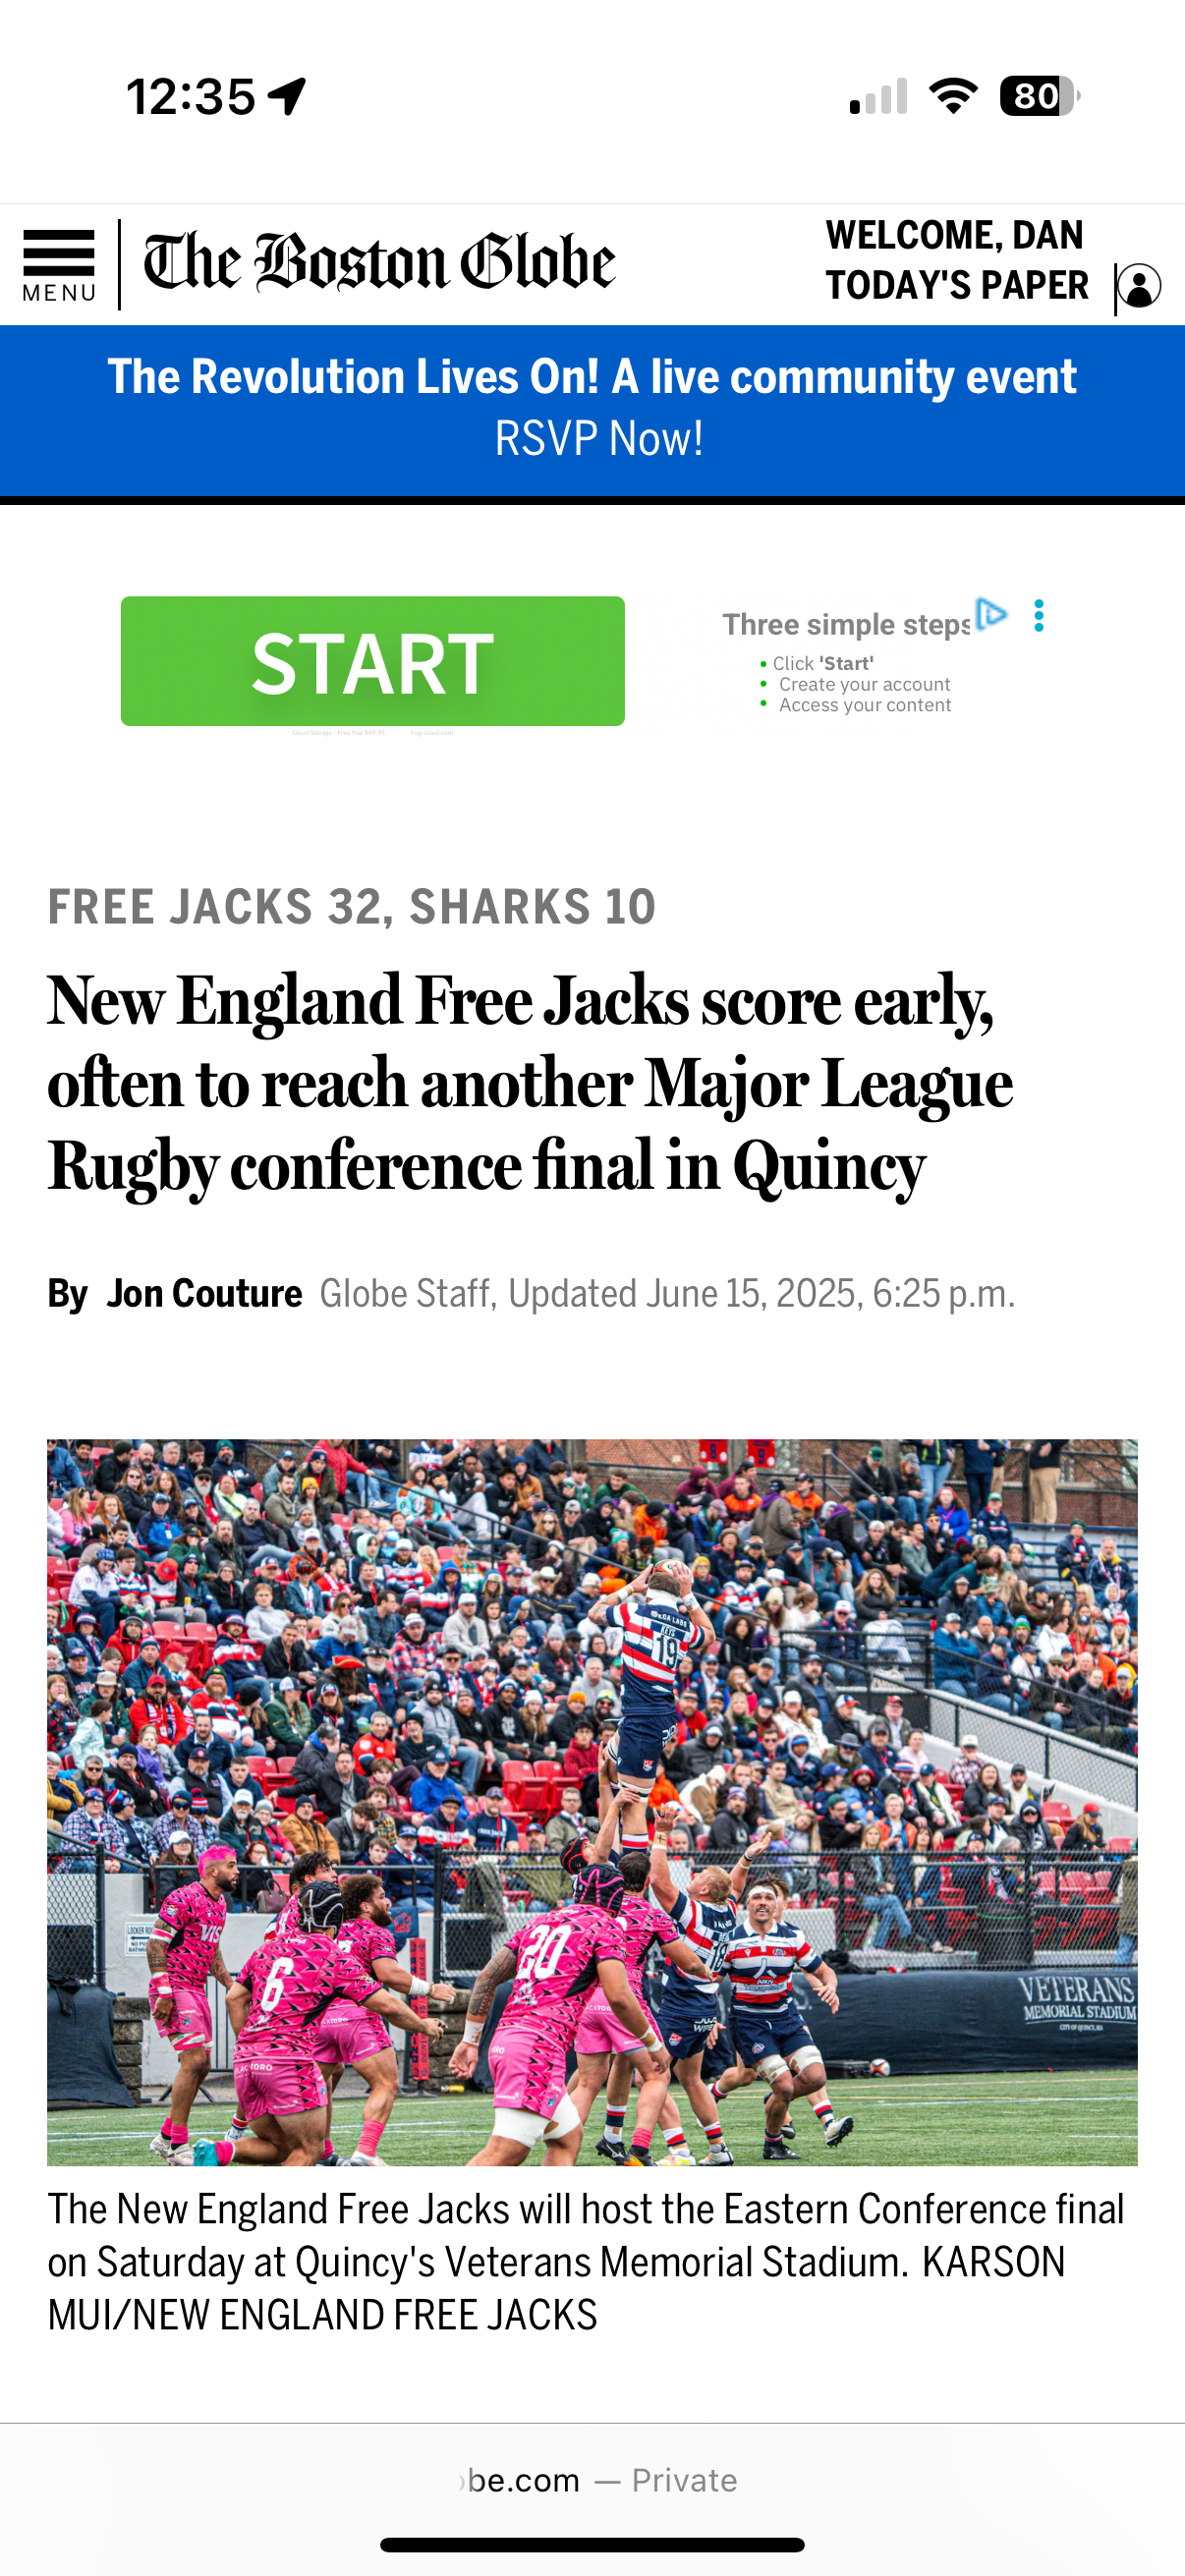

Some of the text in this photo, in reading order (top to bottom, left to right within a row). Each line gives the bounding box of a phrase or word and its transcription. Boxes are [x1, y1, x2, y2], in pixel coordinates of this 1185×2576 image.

[128, 78, 255, 116] 12:35
[1015, 83, 1058, 109] 80
[825, 219, 1083, 254] WELCOME, DAN
[144, 230, 617, 294] The Boston Globe
[24, 284, 95, 302] MENU
[825, 269, 1090, 301] TODAY'S PAPER
[108, 357, 1078, 404] The Revolution Lives On! A live community event
[497, 420, 702, 457] RSVP Now!
[723, 612, 970, 642] Three simple steps
[253, 633, 494, 695] START
[773, 655, 874, 671] Click 'Start'
[780, 677, 950, 695] Create your account
[780, 697, 951, 715] Access your content
[47, 888, 655, 929] FREE JACKS 32, SHARKS 10
[46, 971, 993, 1041] New England Free Jacks score early,
[47, 1053, 1014, 1124] often to reach another Major League
[47, 1136, 929, 1206] Rugby conference final in Quincy
[49, 1277, 1014, 1316] By Jon Couture Globe Staff, Updated June 15, 2025, 6:25 p.m.
[660, 1624, 676, 1638] KEYS
[656, 1635, 678, 1669] 19
[515, 1925, 571, 1980] 20
[261, 1957, 295, 2012] 6
[1018, 1976, 1135, 2003] VETERANS
[1024, 2005, 1137, 2021] MEMORIAL STADIUM
[48, 2192, 1124, 2233] The New England Free Jacks will host the Eastern Conference final
[48, 2245, 1064, 2285] on Saturday at Quincy's Veterans Memorial Stadium. KARSON
[49, 2298, 597, 2331] MUI/NEW ENGLAND FREE JACKS
[634, 2467, 738, 2493] Private
